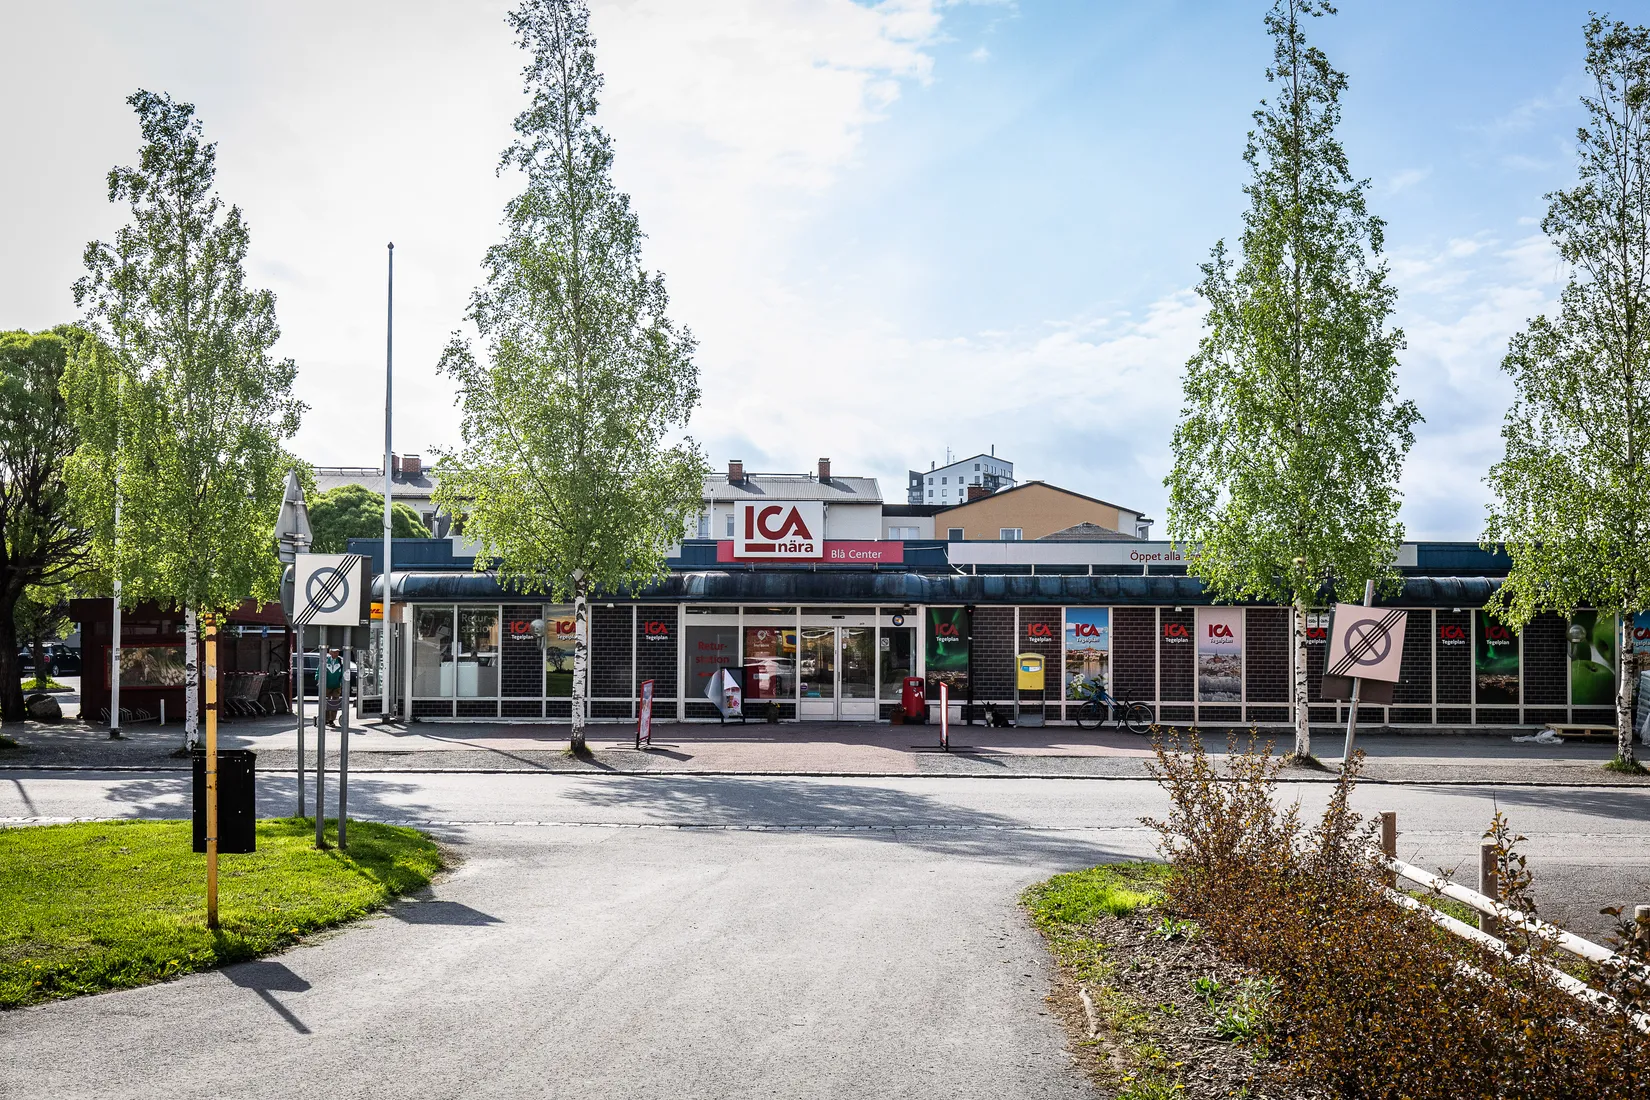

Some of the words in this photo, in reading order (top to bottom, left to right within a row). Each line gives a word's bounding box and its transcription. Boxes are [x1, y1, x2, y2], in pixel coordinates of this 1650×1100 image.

[745, 505, 813, 541] ICA
[778, 540, 814, 553] nära
[831, 549, 846, 559] Blå
[848, 550, 882, 559] Center
[1130, 550, 1161, 562] Öppet
[1164, 552, 1181, 561] alla
[644, 621, 668, 635] ICA
[935, 623, 959, 636] ICA
[1027, 623, 1052, 637] ICA
[1075, 623, 1100, 637] ICA
[1164, 623, 1189, 637] ICA
[1208, 624, 1234, 638] ICA
[1441, 625, 1465, 639] ICA
[1485, 625, 1510, 639] ICA
[697, 641, 728, 651] Retur-
[695, 655, 730, 664] station
